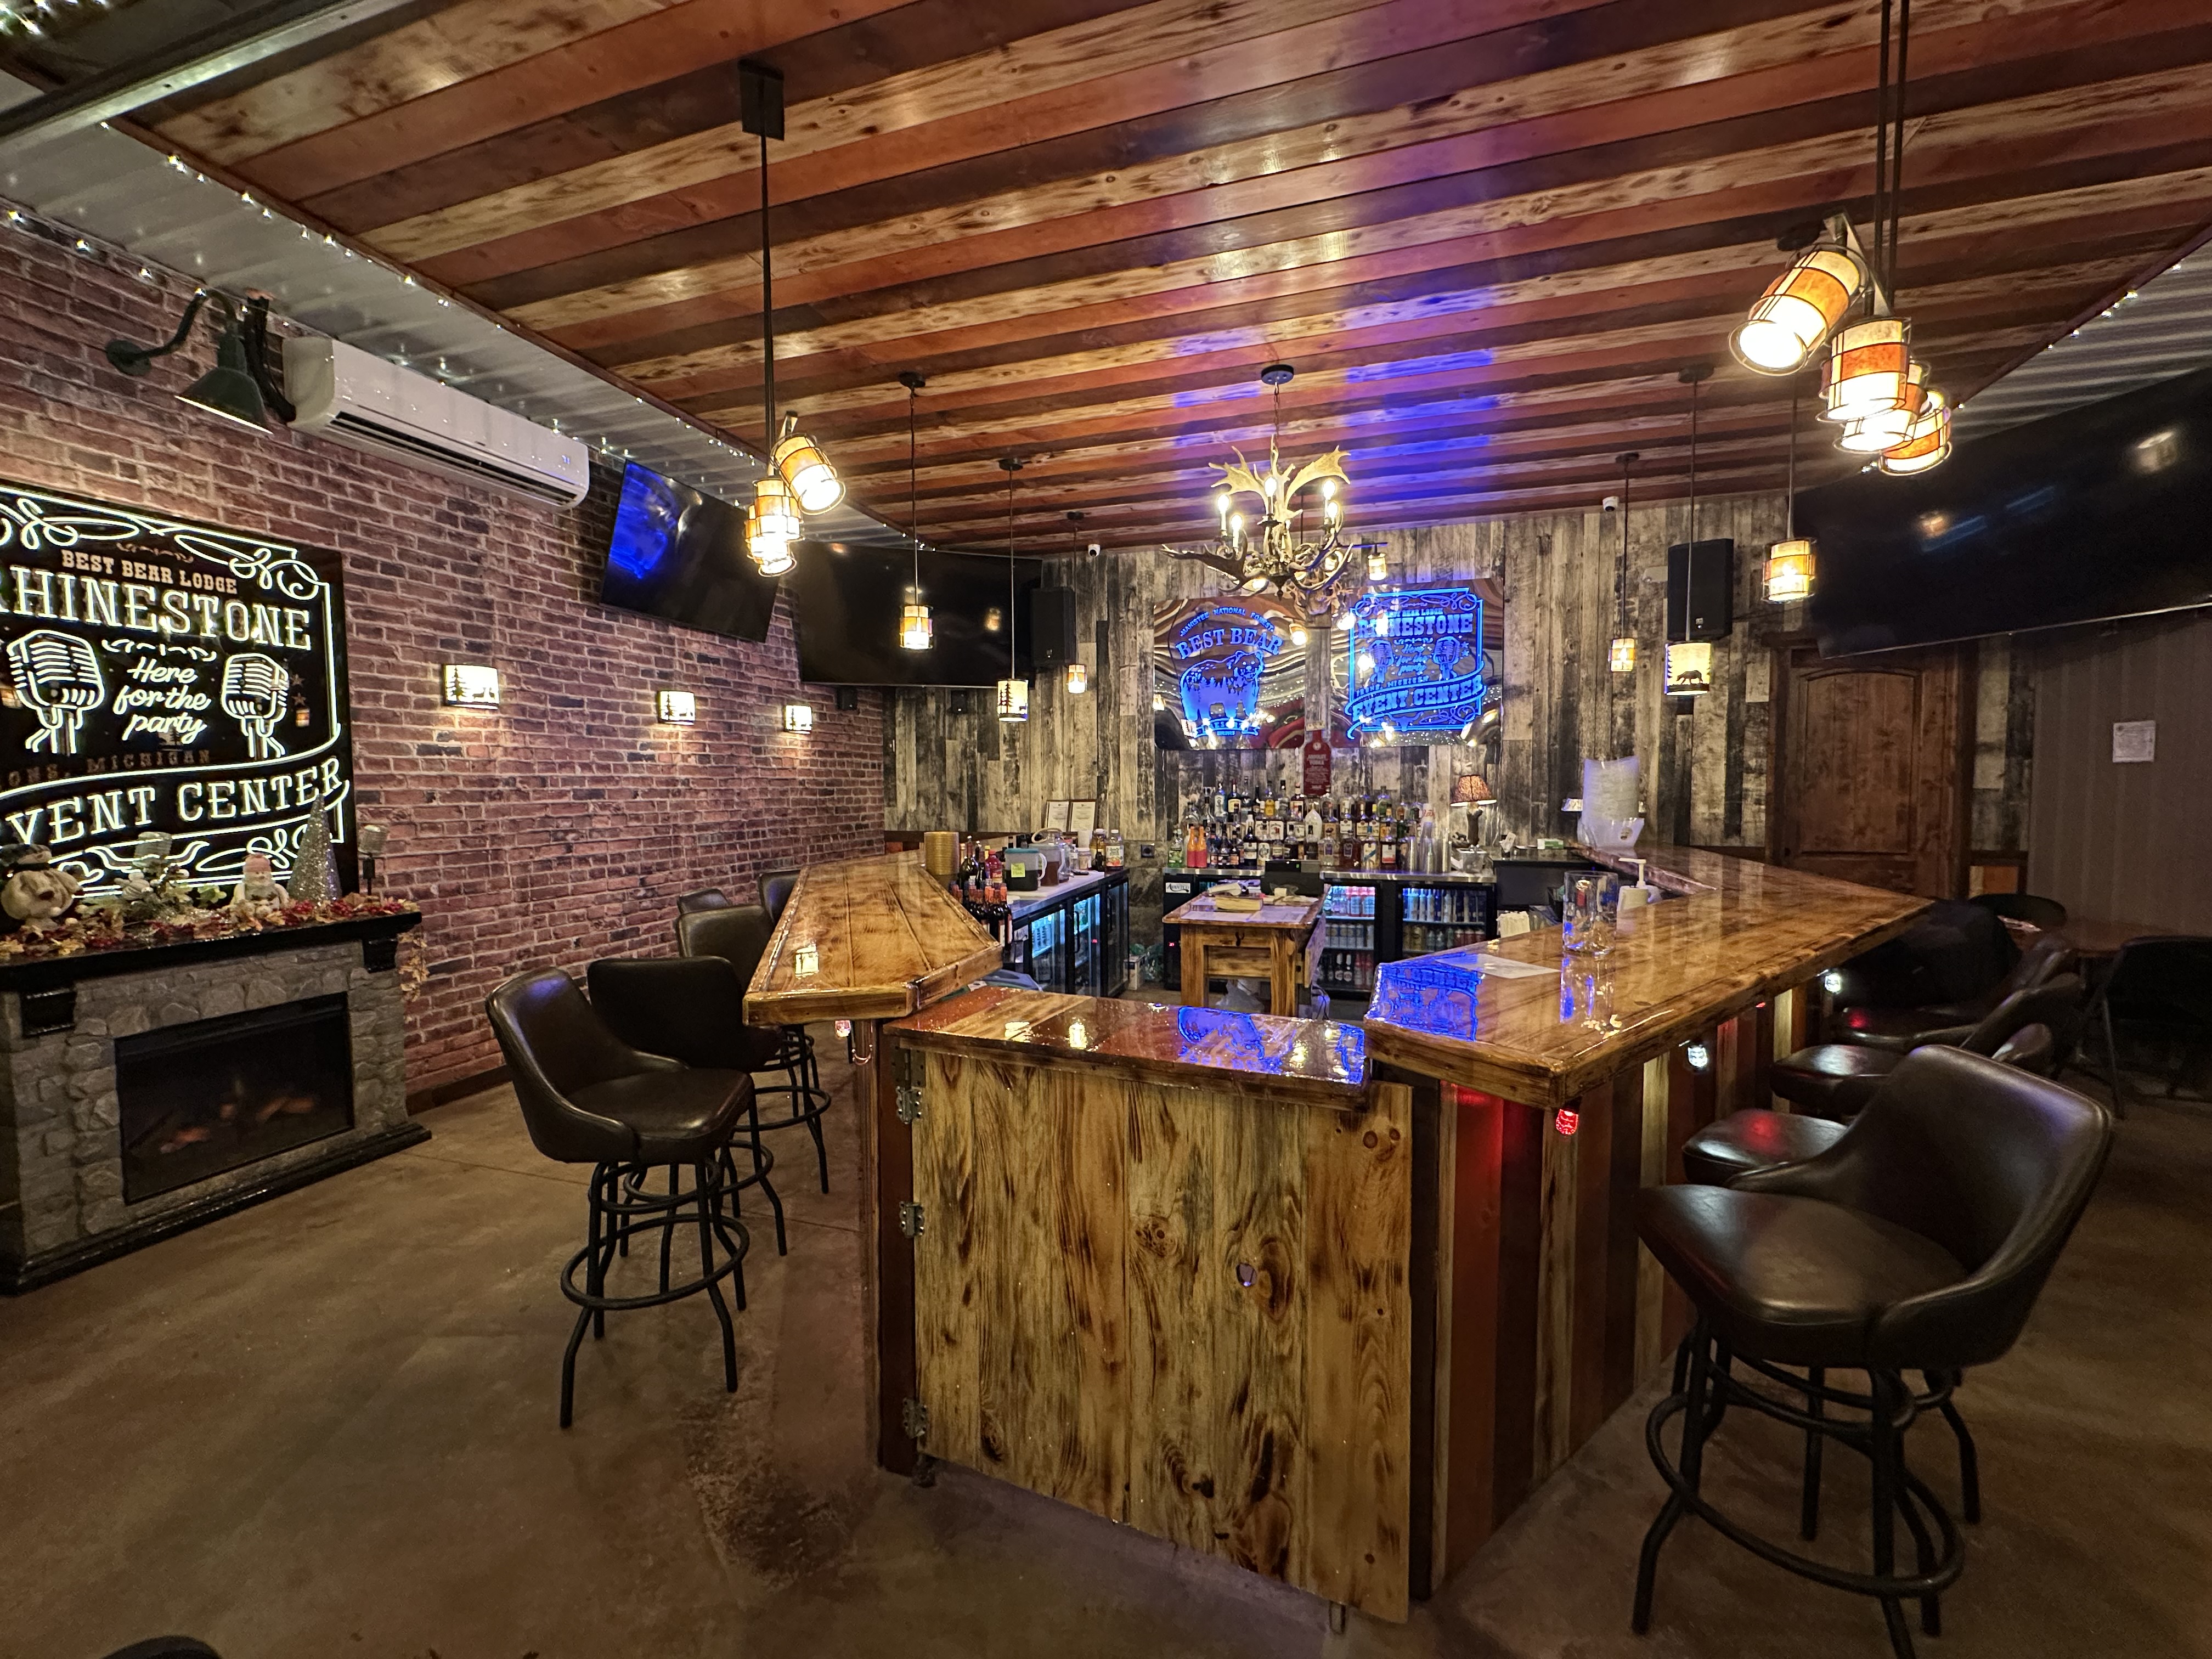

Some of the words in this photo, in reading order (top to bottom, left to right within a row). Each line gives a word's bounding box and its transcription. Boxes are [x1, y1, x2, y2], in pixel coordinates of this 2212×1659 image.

[61, 549, 114, 574] BEST
[121, 560, 173, 584] BEAR
[180, 569, 238, 594] LODGE
[1212, 606, 1246, 616] NATIONAL
[1358, 613, 1473, 638] RNESTONE
[1175, 628, 1225, 659] BEST
[1230, 627, 1284, 655] BEAR
[127, 656, 198, 684] Here
[113, 685, 165, 715] for
[165, 685, 212, 710] the
[1352, 690, 1409, 722] EVENT
[1413, 675, 1482, 706] CENTER
[122, 712, 207, 744] party
[87, 749, 210, 773] MICHIGAN
[178, 757, 342, 821] CENTER
